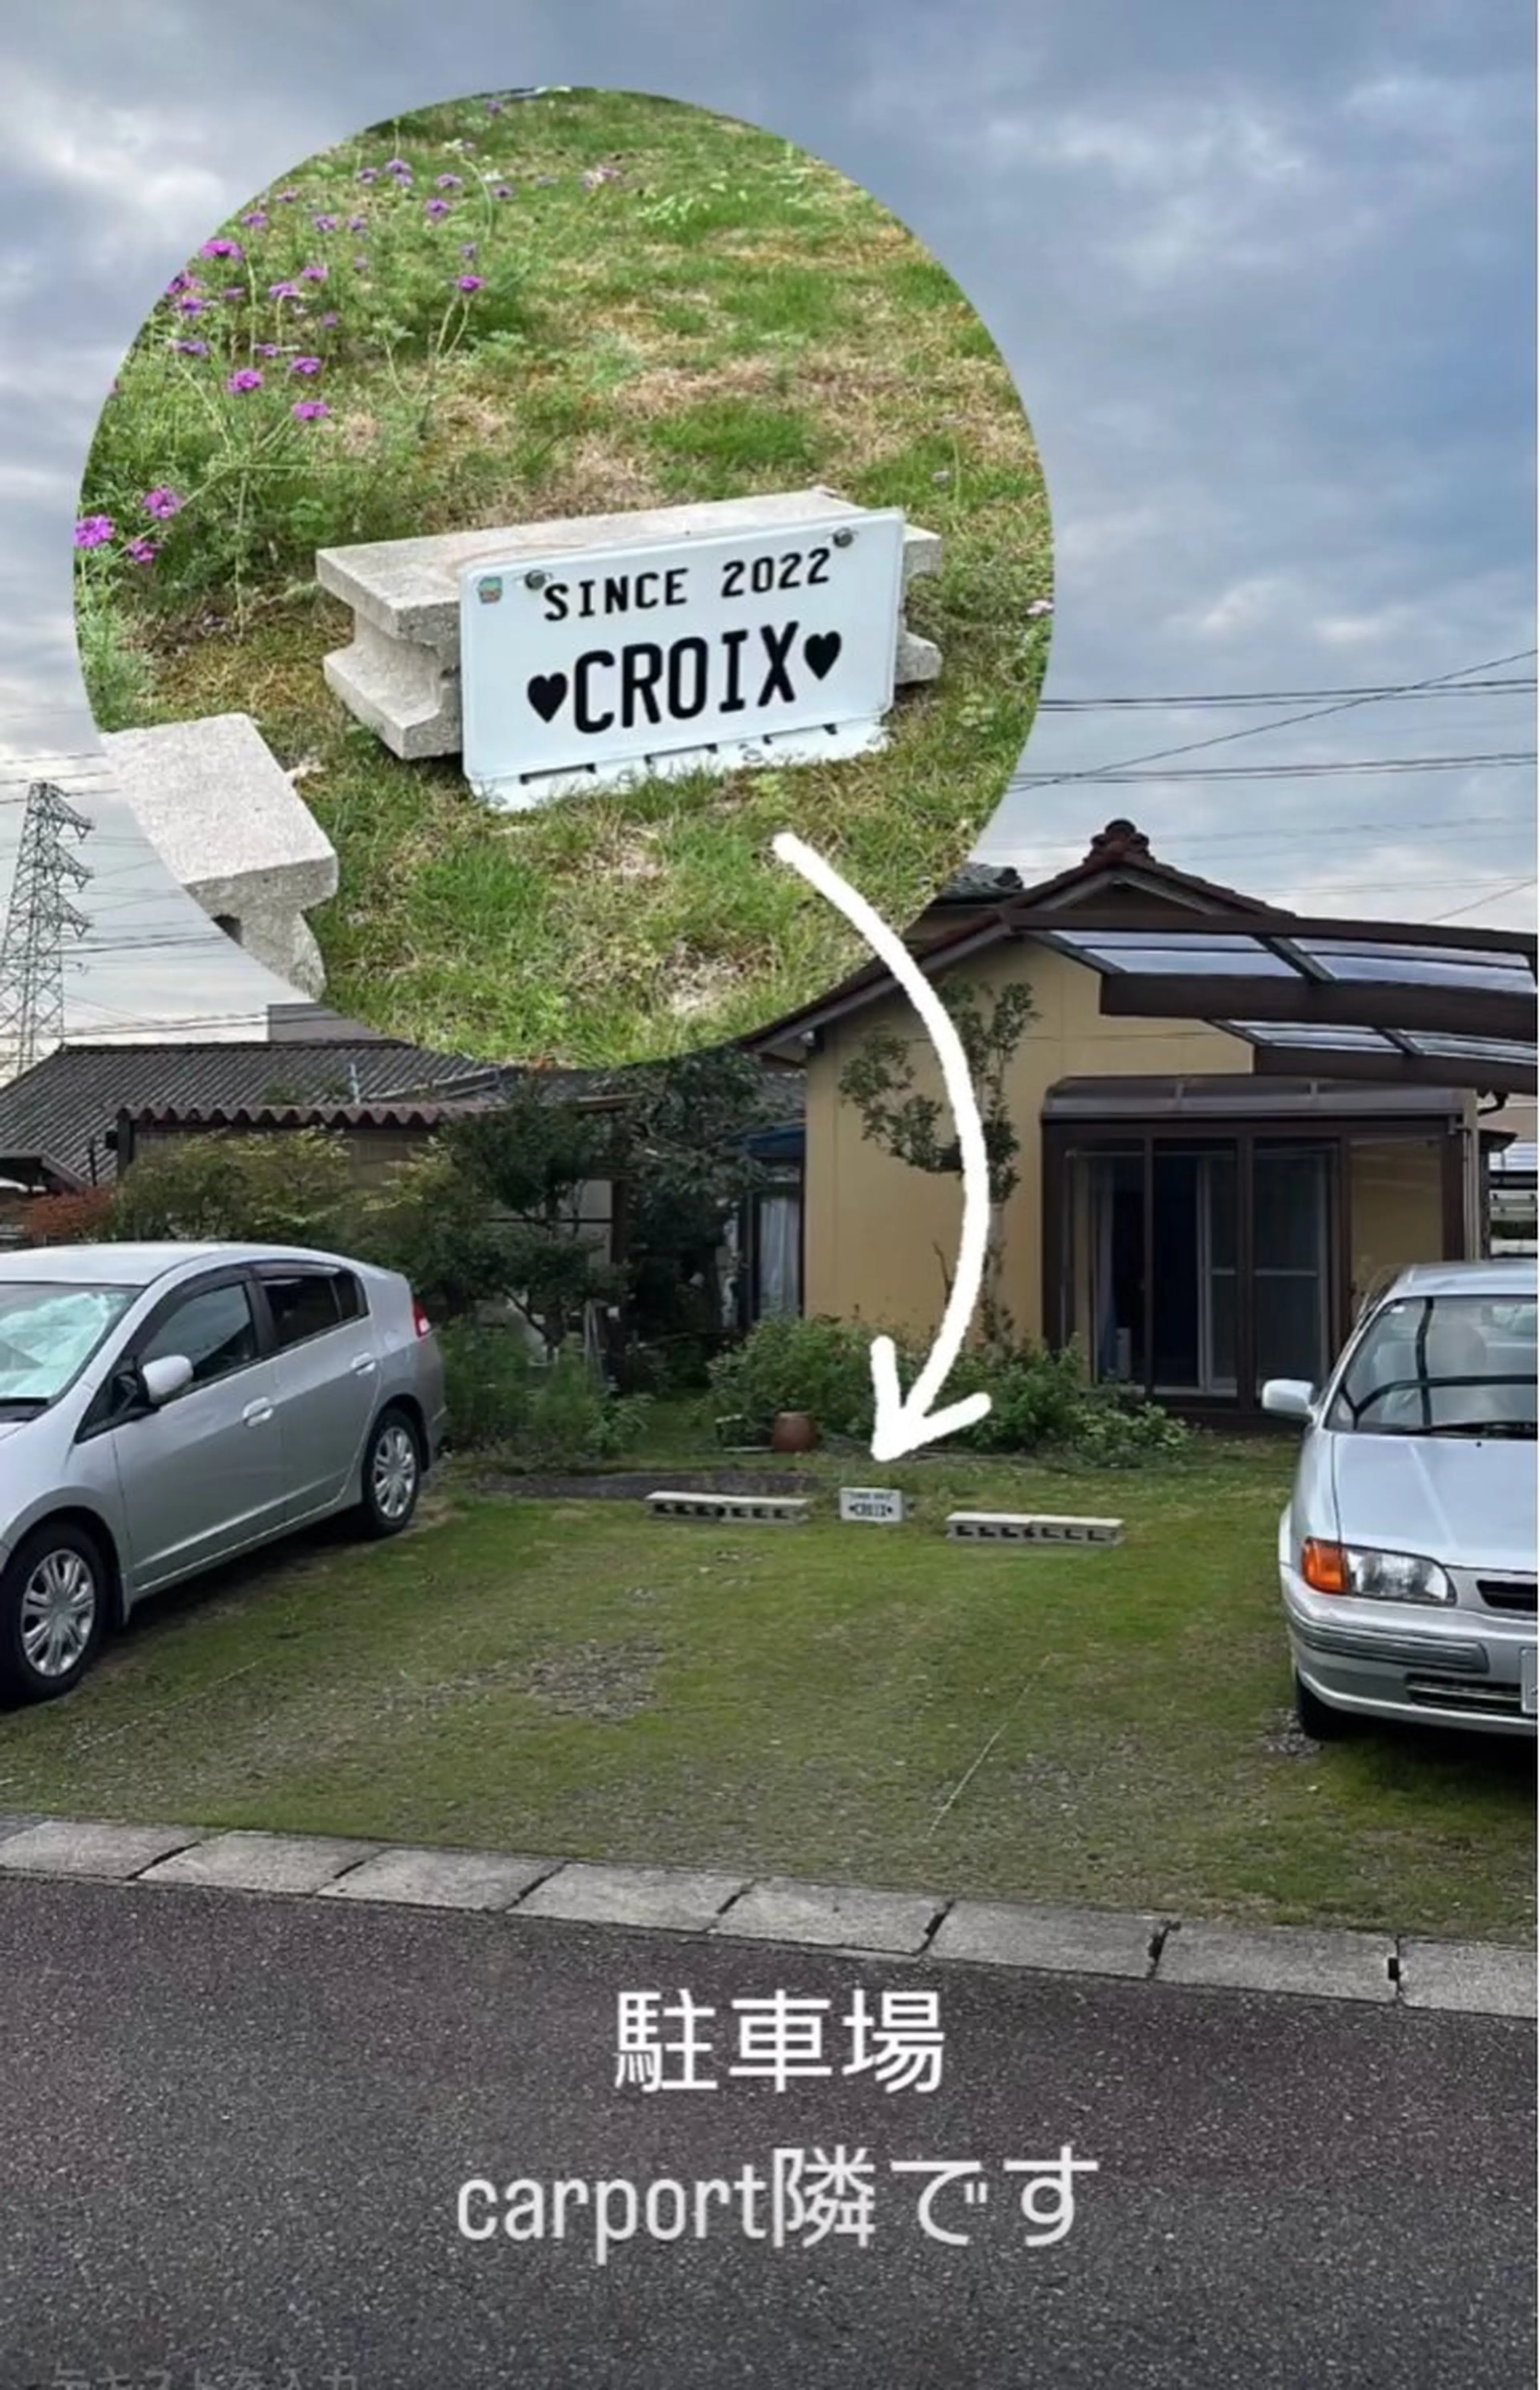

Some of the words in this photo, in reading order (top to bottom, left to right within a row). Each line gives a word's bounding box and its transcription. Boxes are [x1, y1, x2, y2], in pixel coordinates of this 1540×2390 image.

[543, 568, 688, 621] SINCE
[721, 547, 830, 598] 2022
[574, 621, 799, 734] CROIX
